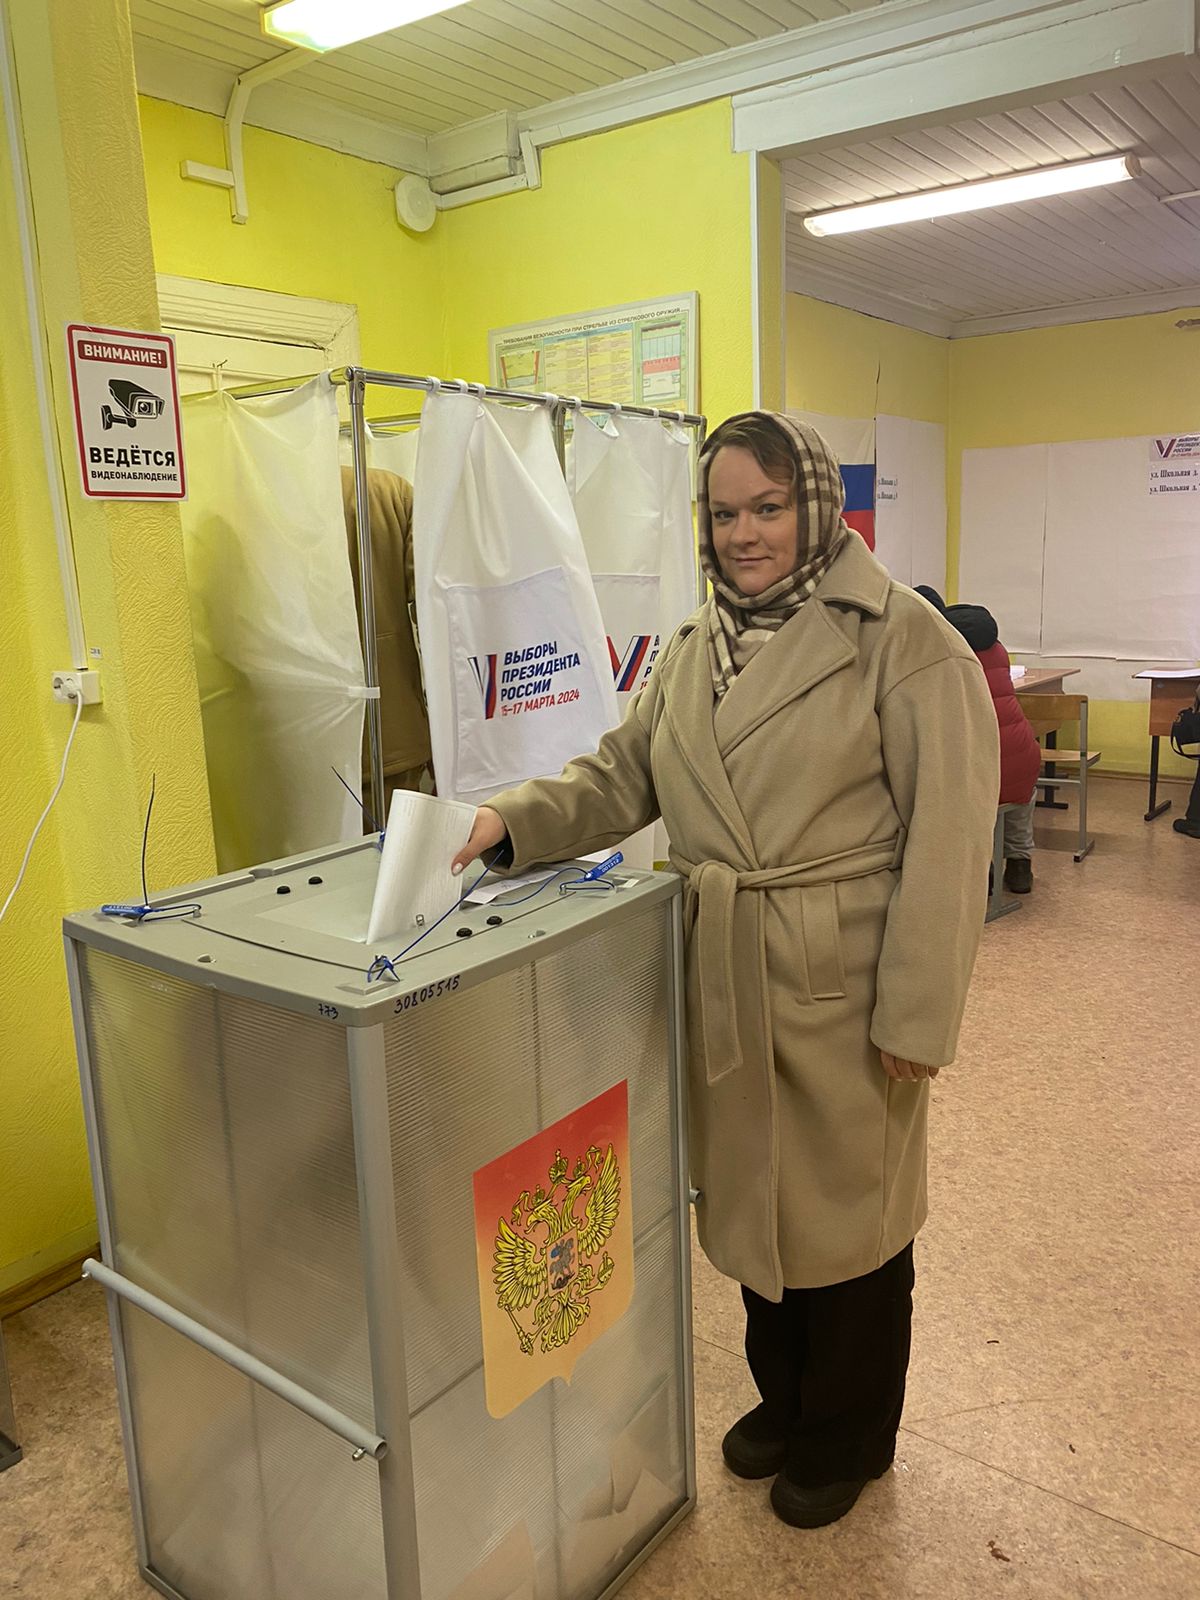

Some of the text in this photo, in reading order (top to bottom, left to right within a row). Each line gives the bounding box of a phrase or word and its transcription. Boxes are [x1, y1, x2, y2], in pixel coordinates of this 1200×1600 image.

[83, 344, 162, 365] ВНИМАНИЕ!
[89, 445, 176, 468] ВЕДЁТСЯ
[91, 470, 178, 482] ВИДЕОНАБЛЮДЕНИЕ
[504, 641, 557, 665] ВЫБОРЫ
[501, 652, 581, 684] ПРЕЗИДЕНТА
[500, 678, 552, 701] РОССИИ
[524, 694, 555, 712] МАРТА
[557, 688, 580, 705] 2024
[394, 974, 461, 1014] 30805515
[318, 1003, 339, 1020] 773
